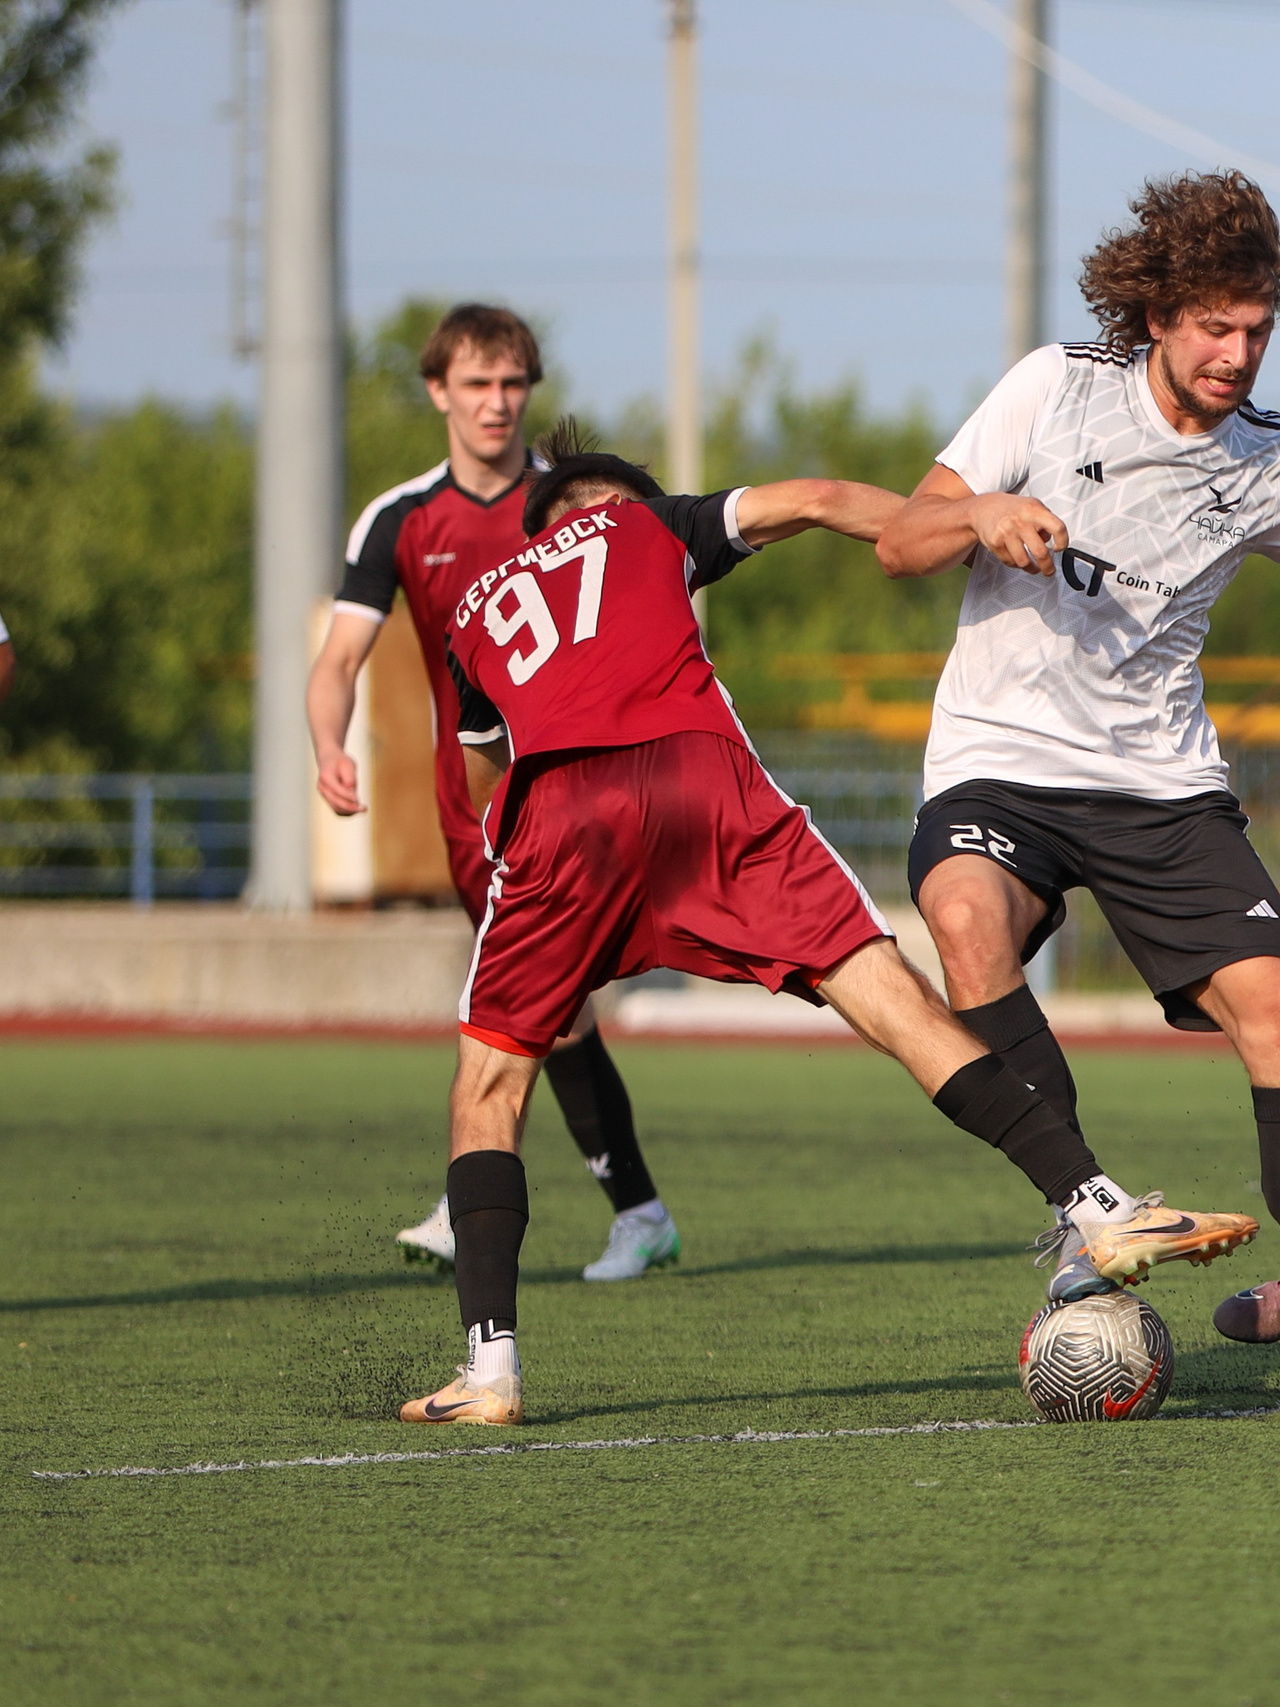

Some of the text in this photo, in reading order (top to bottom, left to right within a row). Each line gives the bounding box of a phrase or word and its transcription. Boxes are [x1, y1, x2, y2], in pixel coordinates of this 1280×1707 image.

[456, 510, 618, 629] СЕРГИЕВСК
[1116, 571, 1150, 591] Coin
[483, 535, 608, 687] 97
[949, 824, 1018, 868] 22
